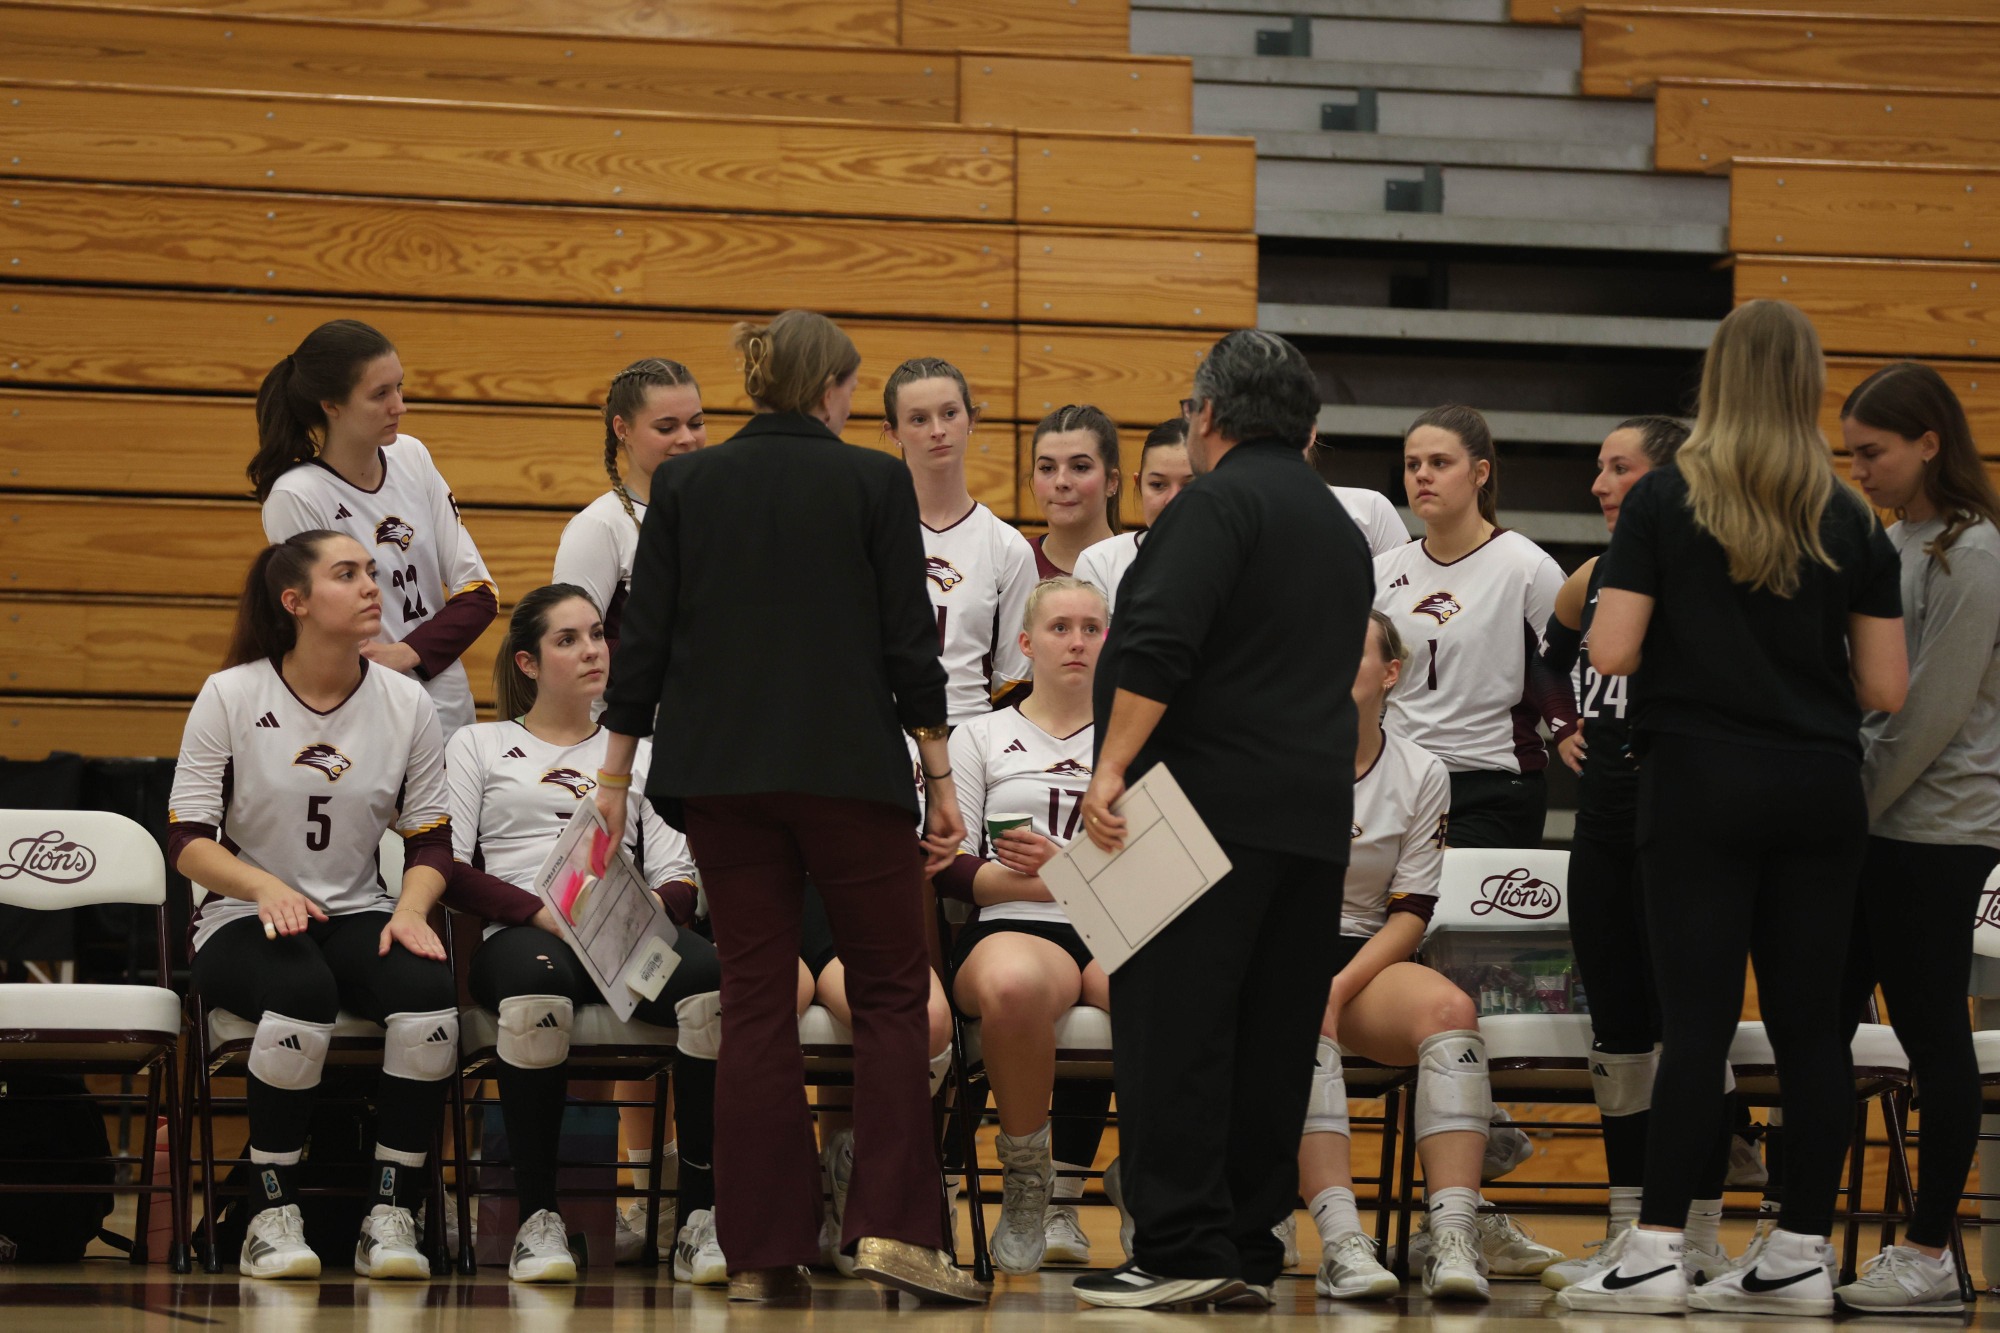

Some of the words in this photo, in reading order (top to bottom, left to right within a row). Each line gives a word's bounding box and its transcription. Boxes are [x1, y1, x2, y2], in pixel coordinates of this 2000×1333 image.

[392, 564, 429, 623] 22
[1427, 639, 1438, 690] 1
[1583, 666, 1629, 719] 24
[306, 795, 333, 851] 5
[1048, 787, 1088, 841] 17
[0, 830, 97, 885] Lions
[1470, 867, 1562, 920] Lions
